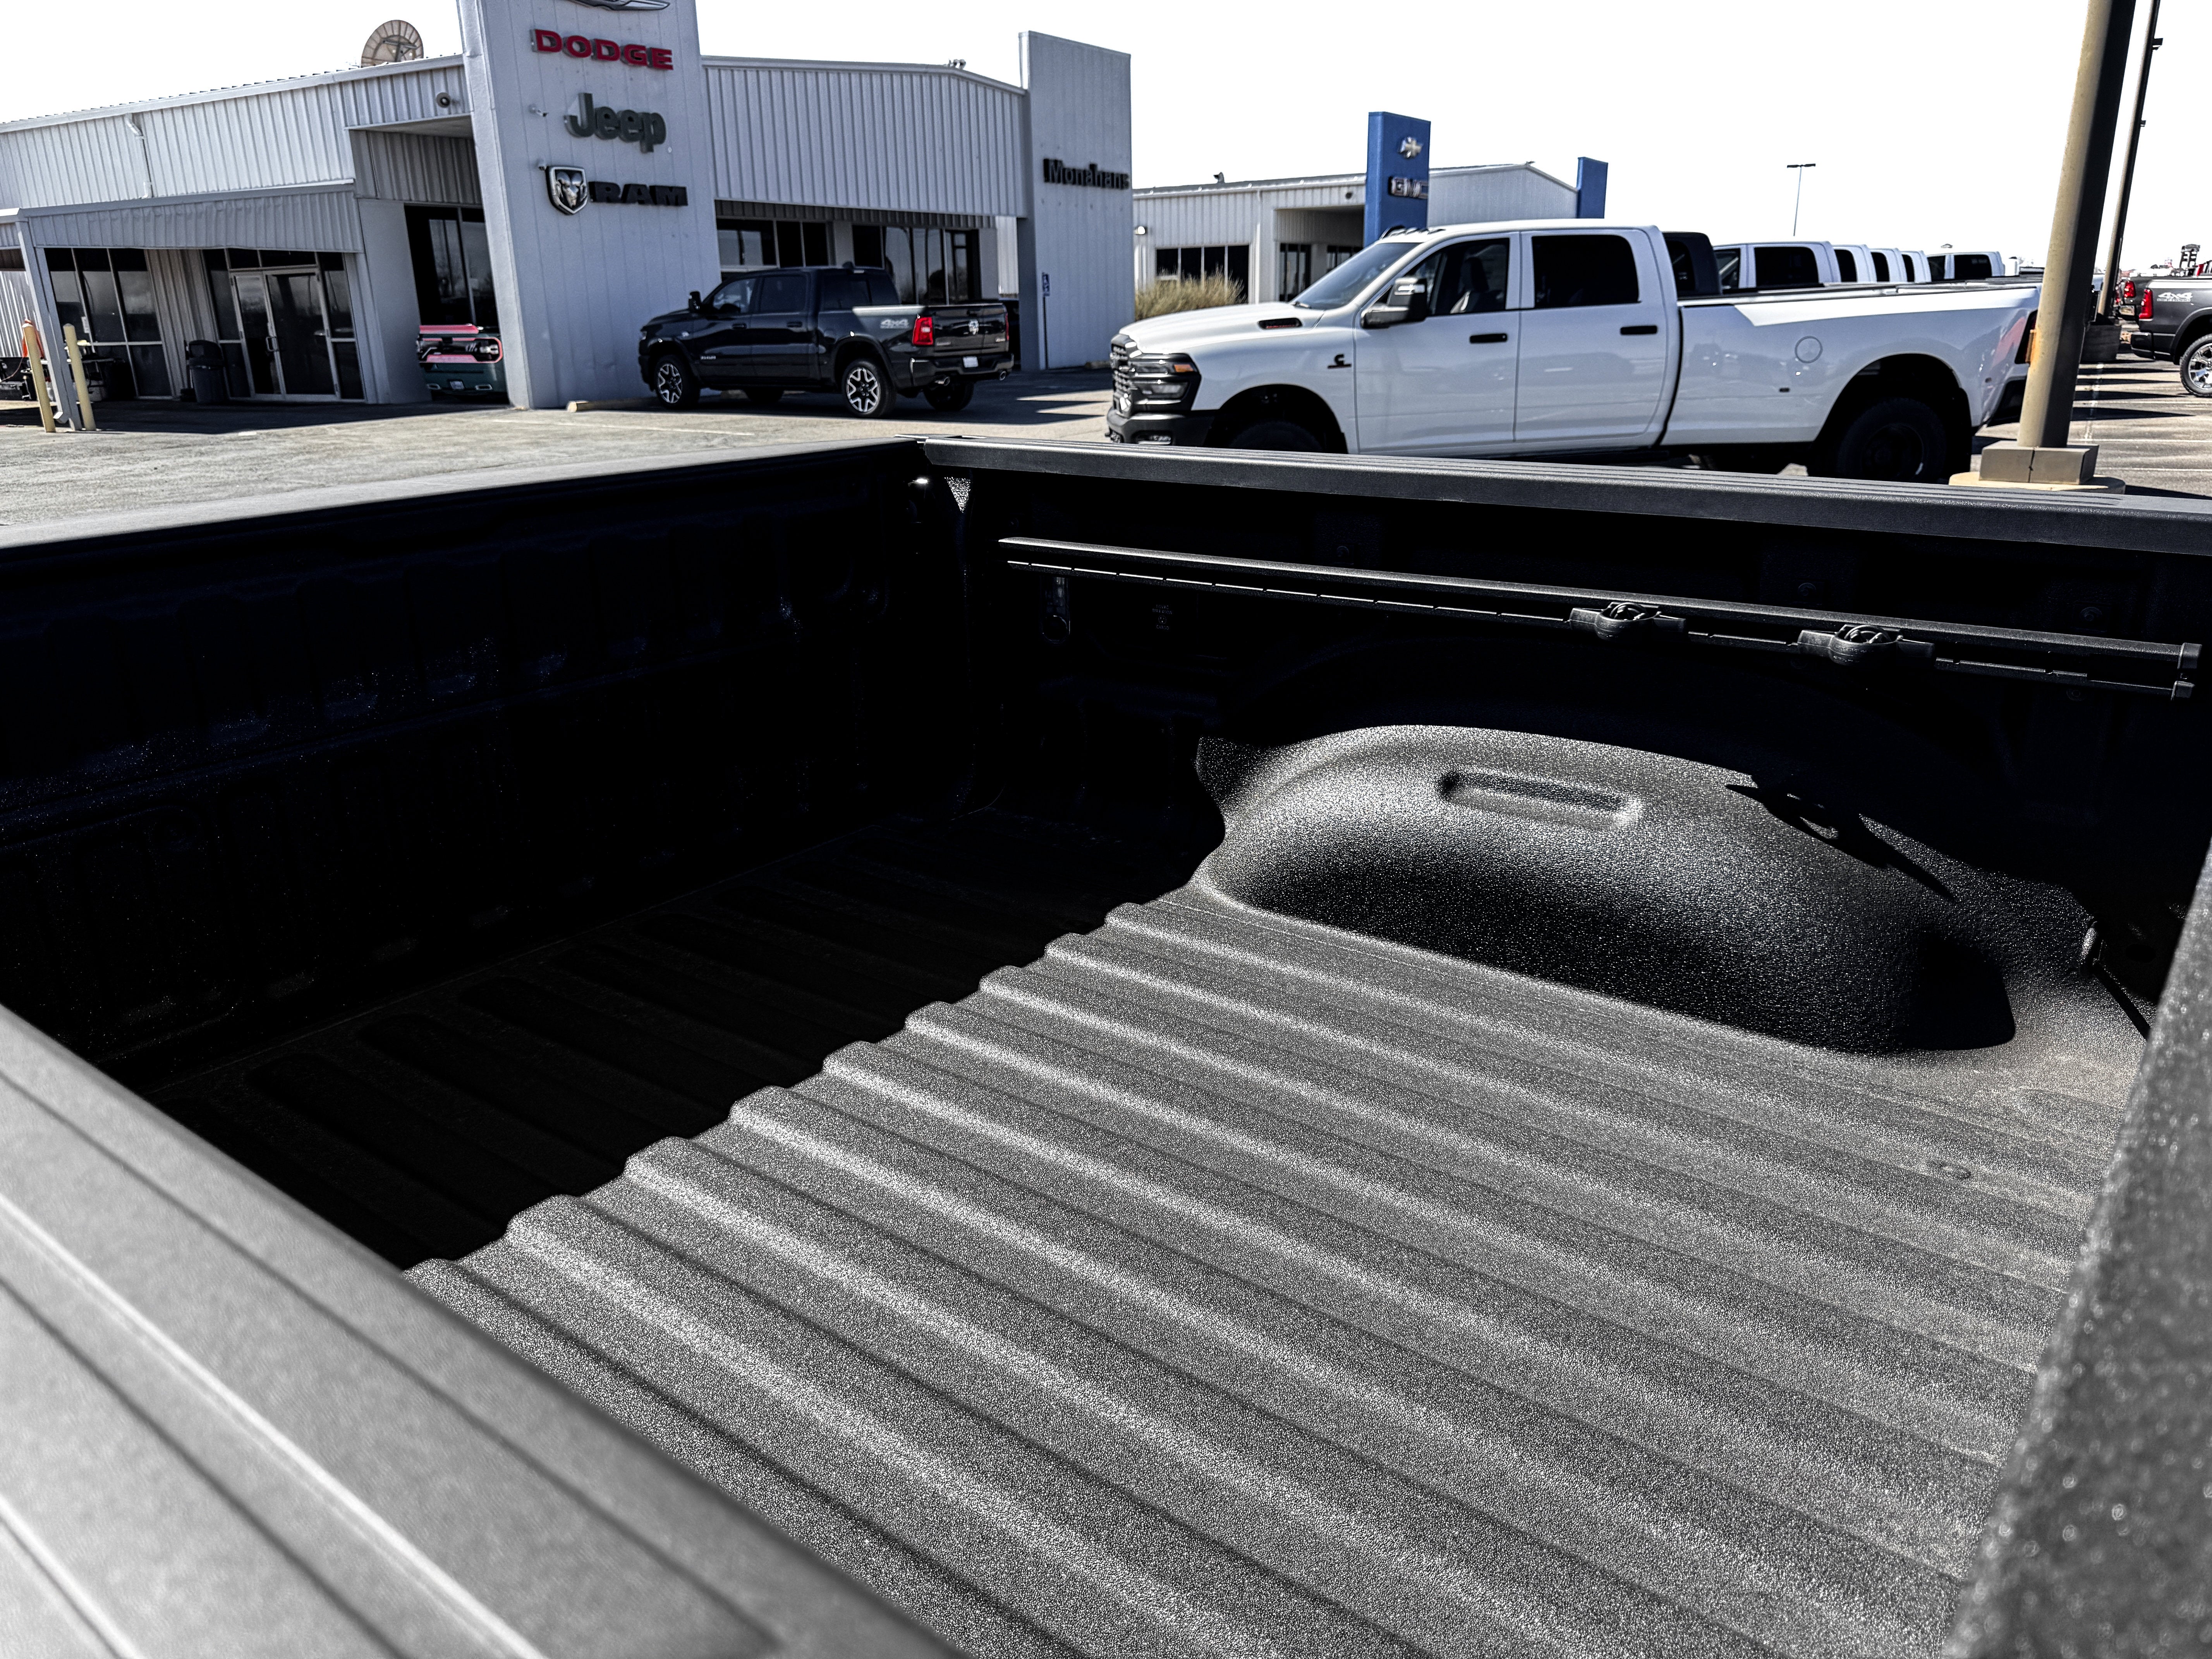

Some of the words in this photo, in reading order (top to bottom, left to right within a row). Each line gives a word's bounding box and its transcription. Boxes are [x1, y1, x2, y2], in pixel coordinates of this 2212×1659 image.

[531, 29, 673, 70] DODGE
[564, 93, 666, 152] Jeep
[1043, 158, 1129, 190] Monahans
[589, 181, 688, 206] RAM
